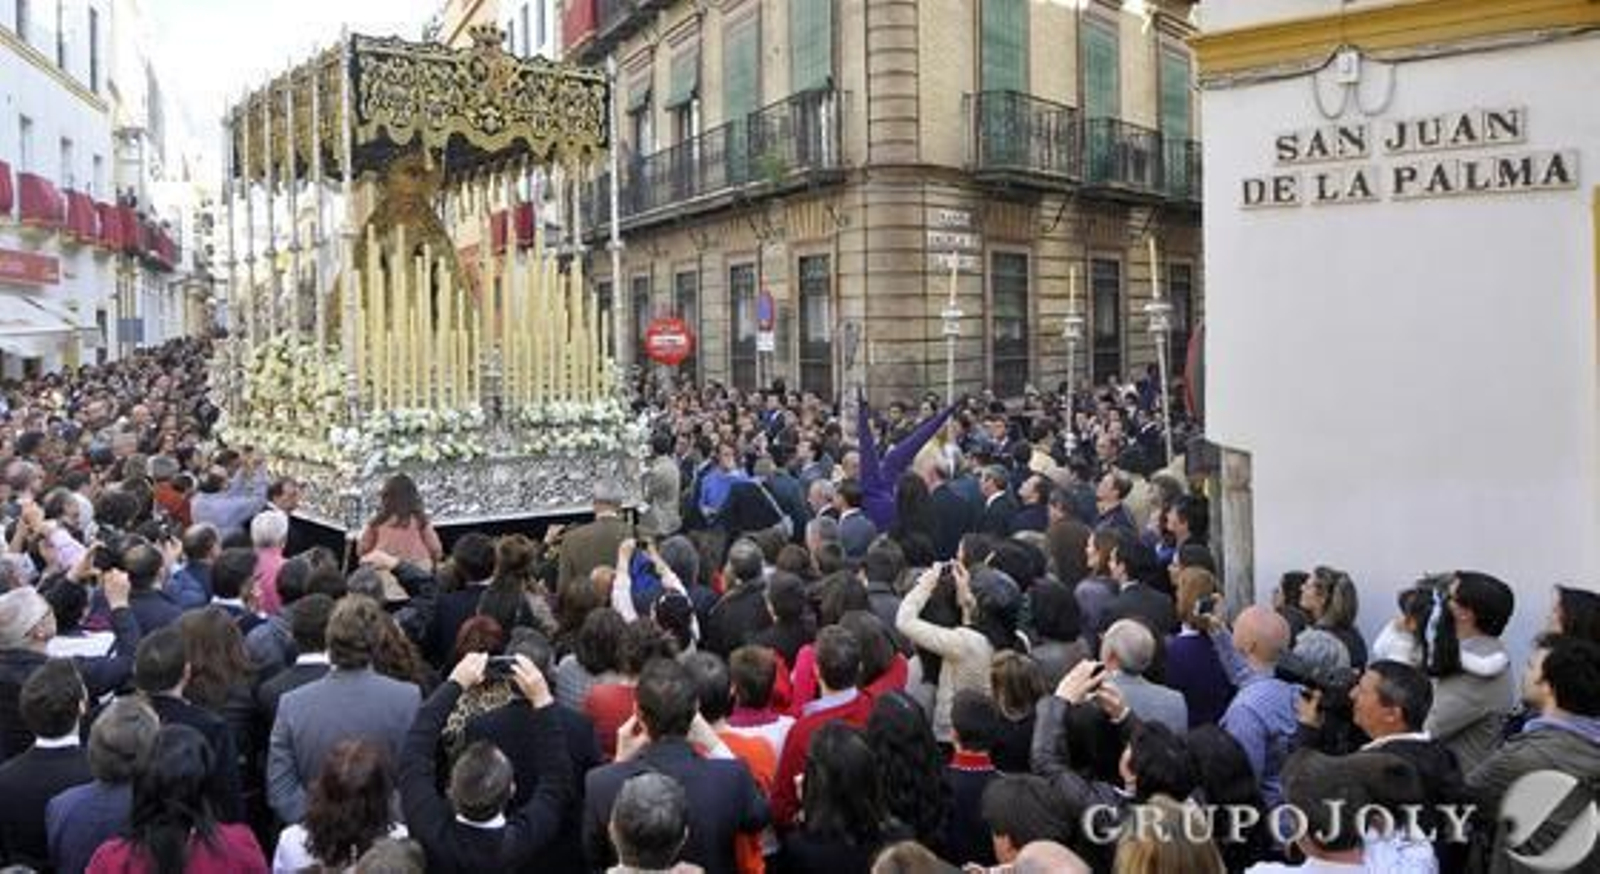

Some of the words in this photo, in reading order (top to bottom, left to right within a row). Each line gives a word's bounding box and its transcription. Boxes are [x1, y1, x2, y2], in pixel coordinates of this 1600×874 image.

[1275, 124, 1367, 161] SAN
[1385, 109, 1519, 149] JUAN
[1242, 175, 1297, 206] DE
[1315, 170, 1372, 201] LA
[1392, 152, 1572, 194] PALMA
